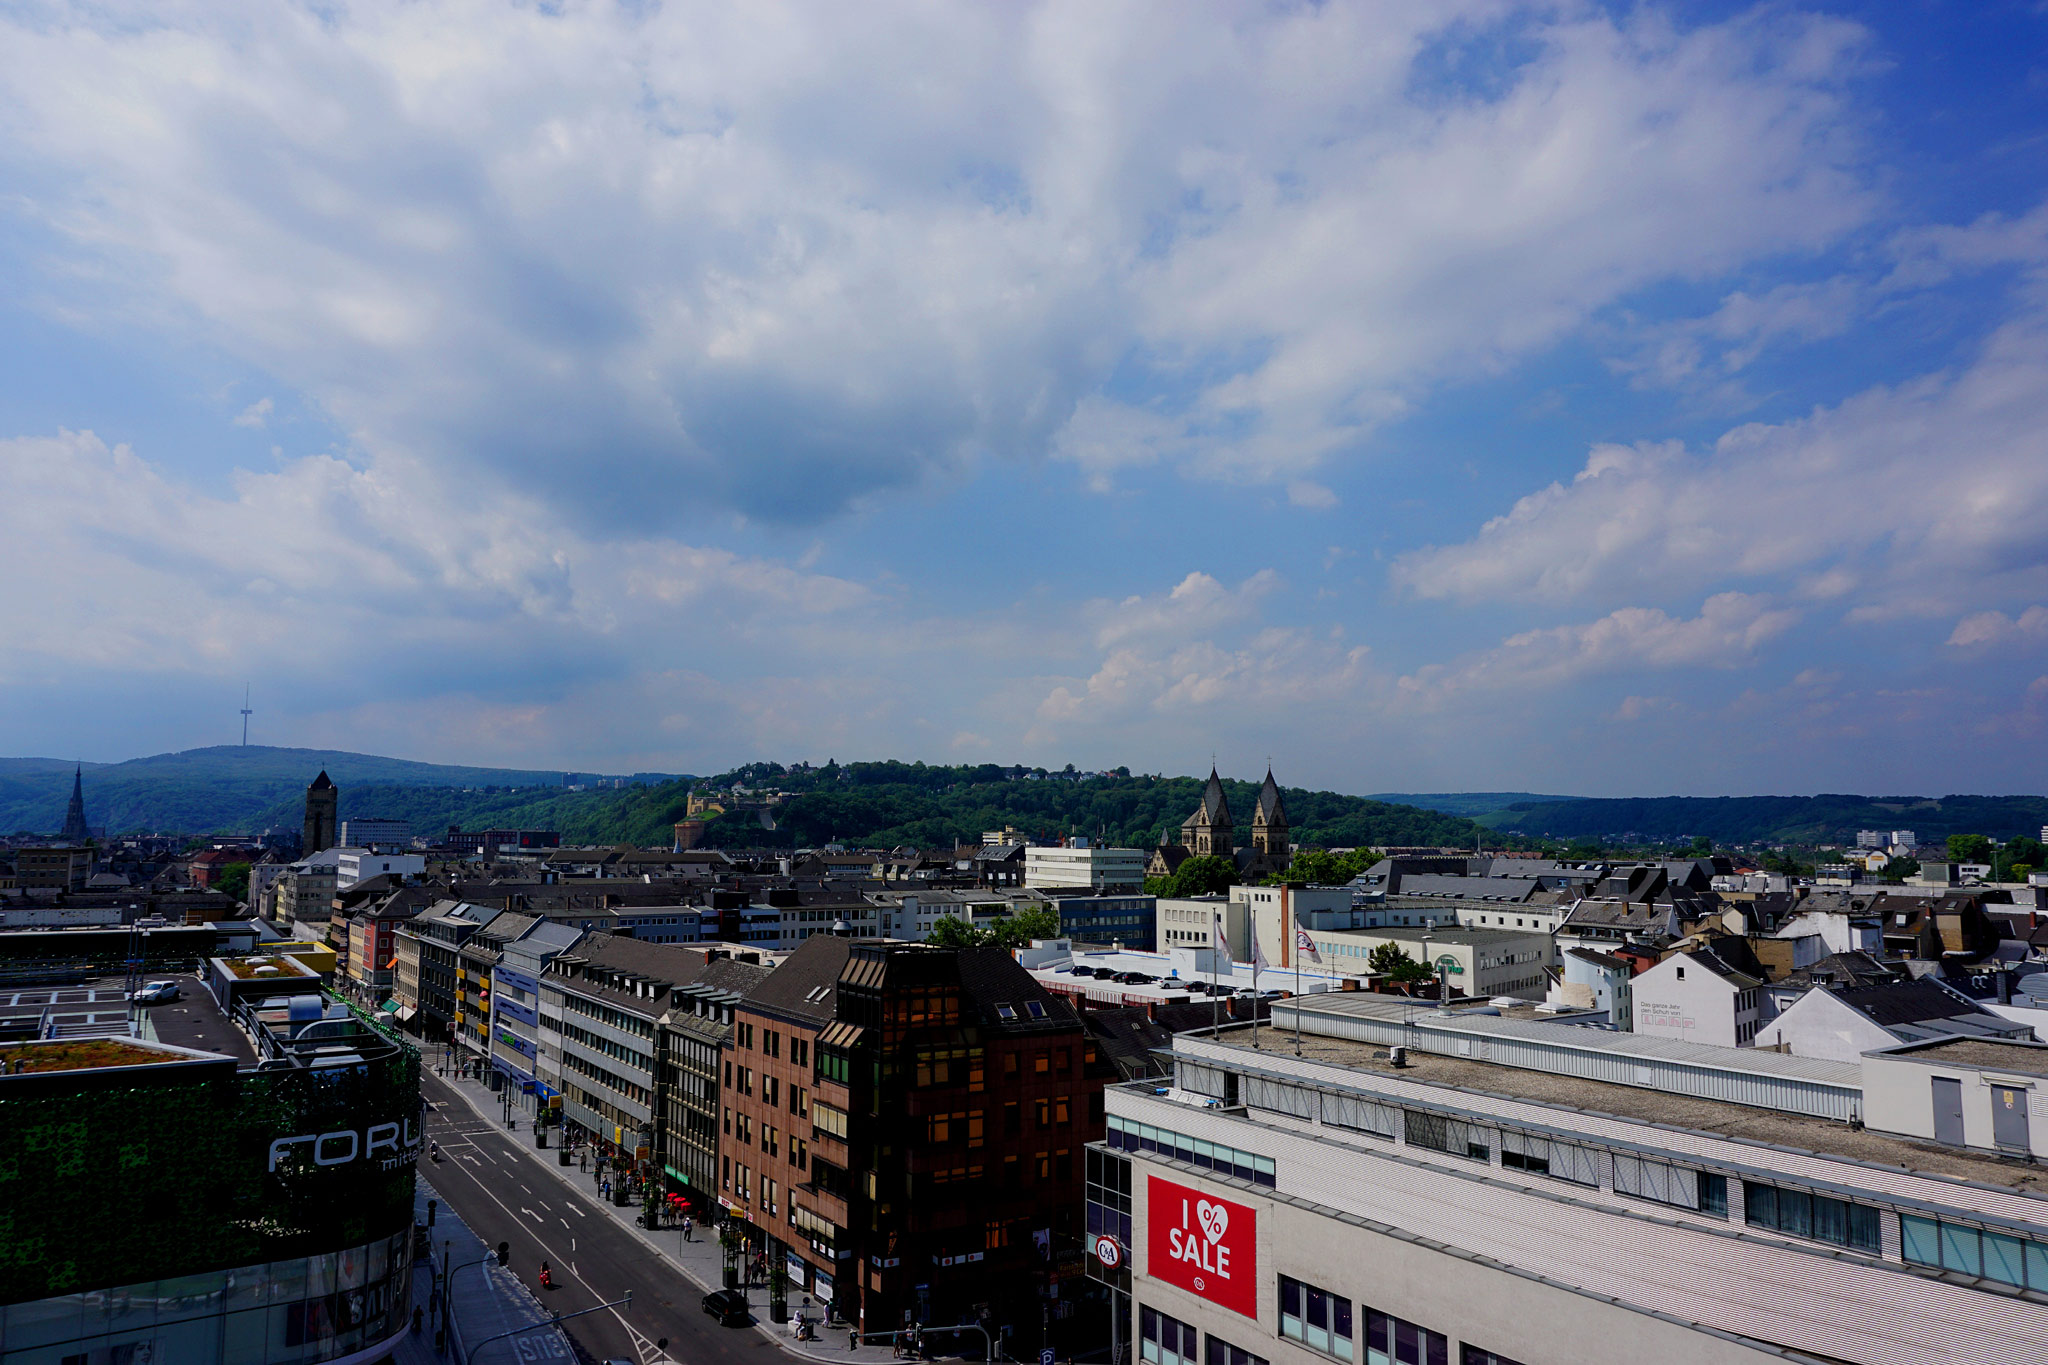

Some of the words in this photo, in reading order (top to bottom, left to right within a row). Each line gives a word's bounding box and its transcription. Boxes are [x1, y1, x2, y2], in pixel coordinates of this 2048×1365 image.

[383, 1149, 419, 1172] mitte
[1182, 1198, 1188, 1230] I
[1099, 1243, 1116, 1262] C&A
[1169, 1227, 1230, 1280] SALE
[517, 1334, 566, 1361] BUS
[1043, 1353, 1052, 1365] P
